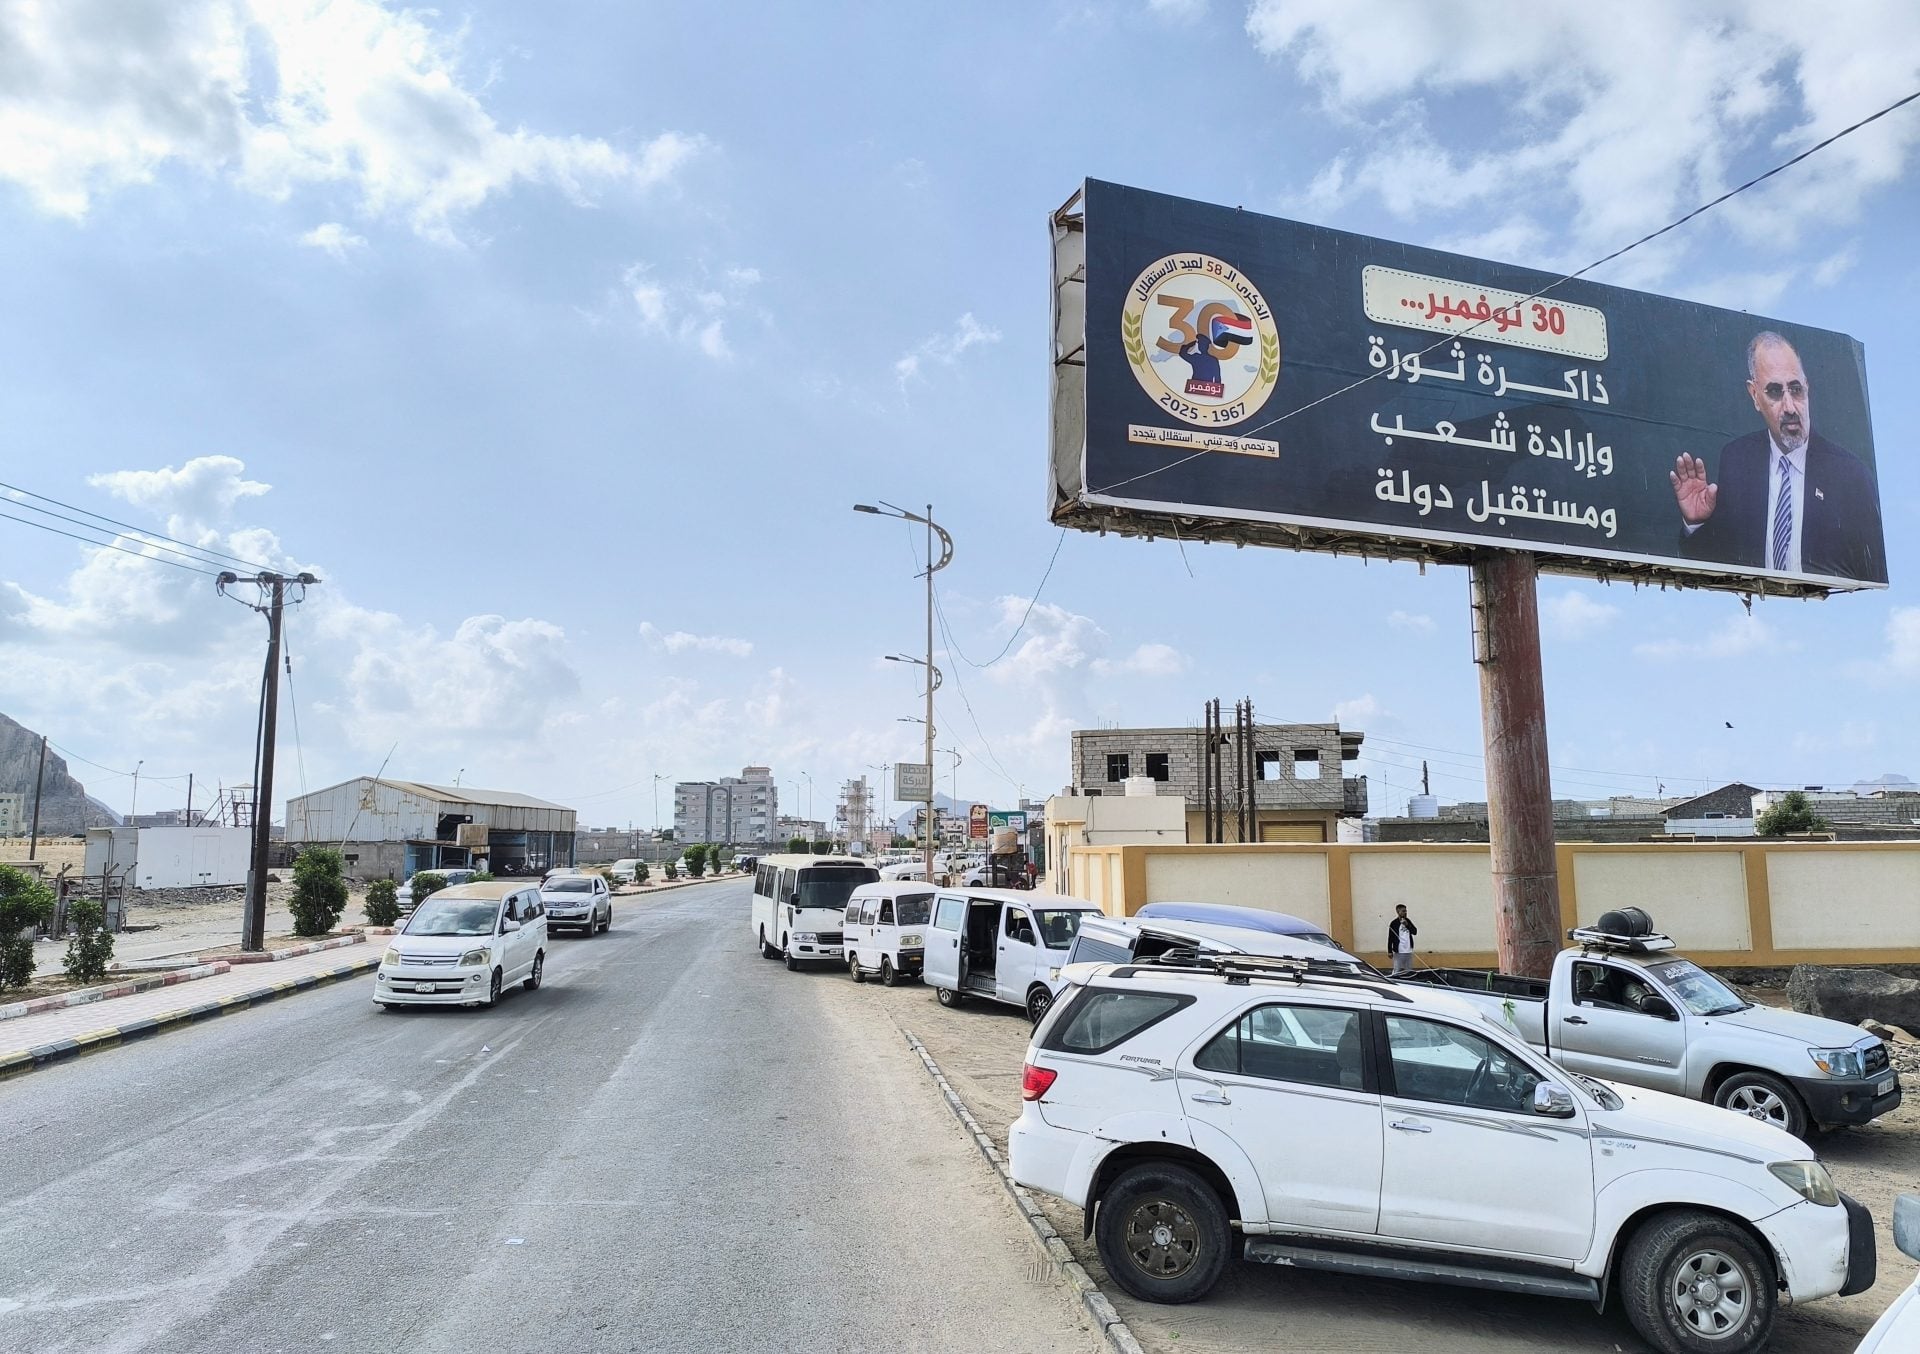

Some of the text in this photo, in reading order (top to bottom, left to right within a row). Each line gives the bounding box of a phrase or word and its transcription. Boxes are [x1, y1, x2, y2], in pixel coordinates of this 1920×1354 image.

[1180, 257, 1203, 272] لعيد
[1206, 261, 1223, 276] 58
[1136, 258, 1178, 302] الاستقلال
[1236, 283, 1270, 320] الذكرى
[1401, 292, 1565, 335] 30 نوفمبر...
[1368, 335, 1610, 404] ذاكرة ثورة
[1189, 382, 1221, 394] نوفمبر
[1160, 392, 1198, 420] 2025
[1212, 402, 1245, 422] 1967
[1132, 428, 1156, 441] يتجدد
[1159, 430, 1193, 443] استقلال
[1203, 437, 1223, 448] تبني
[1241, 442, 1265, 452] تحمي
[1267, 445, 1275, 454] يد
[1370, 411, 1614, 478] وإرادة شعب
[1375, 467, 1618, 539] ومستقبل دولة
[1120, 1054, 1161, 1066] FORTUNER
